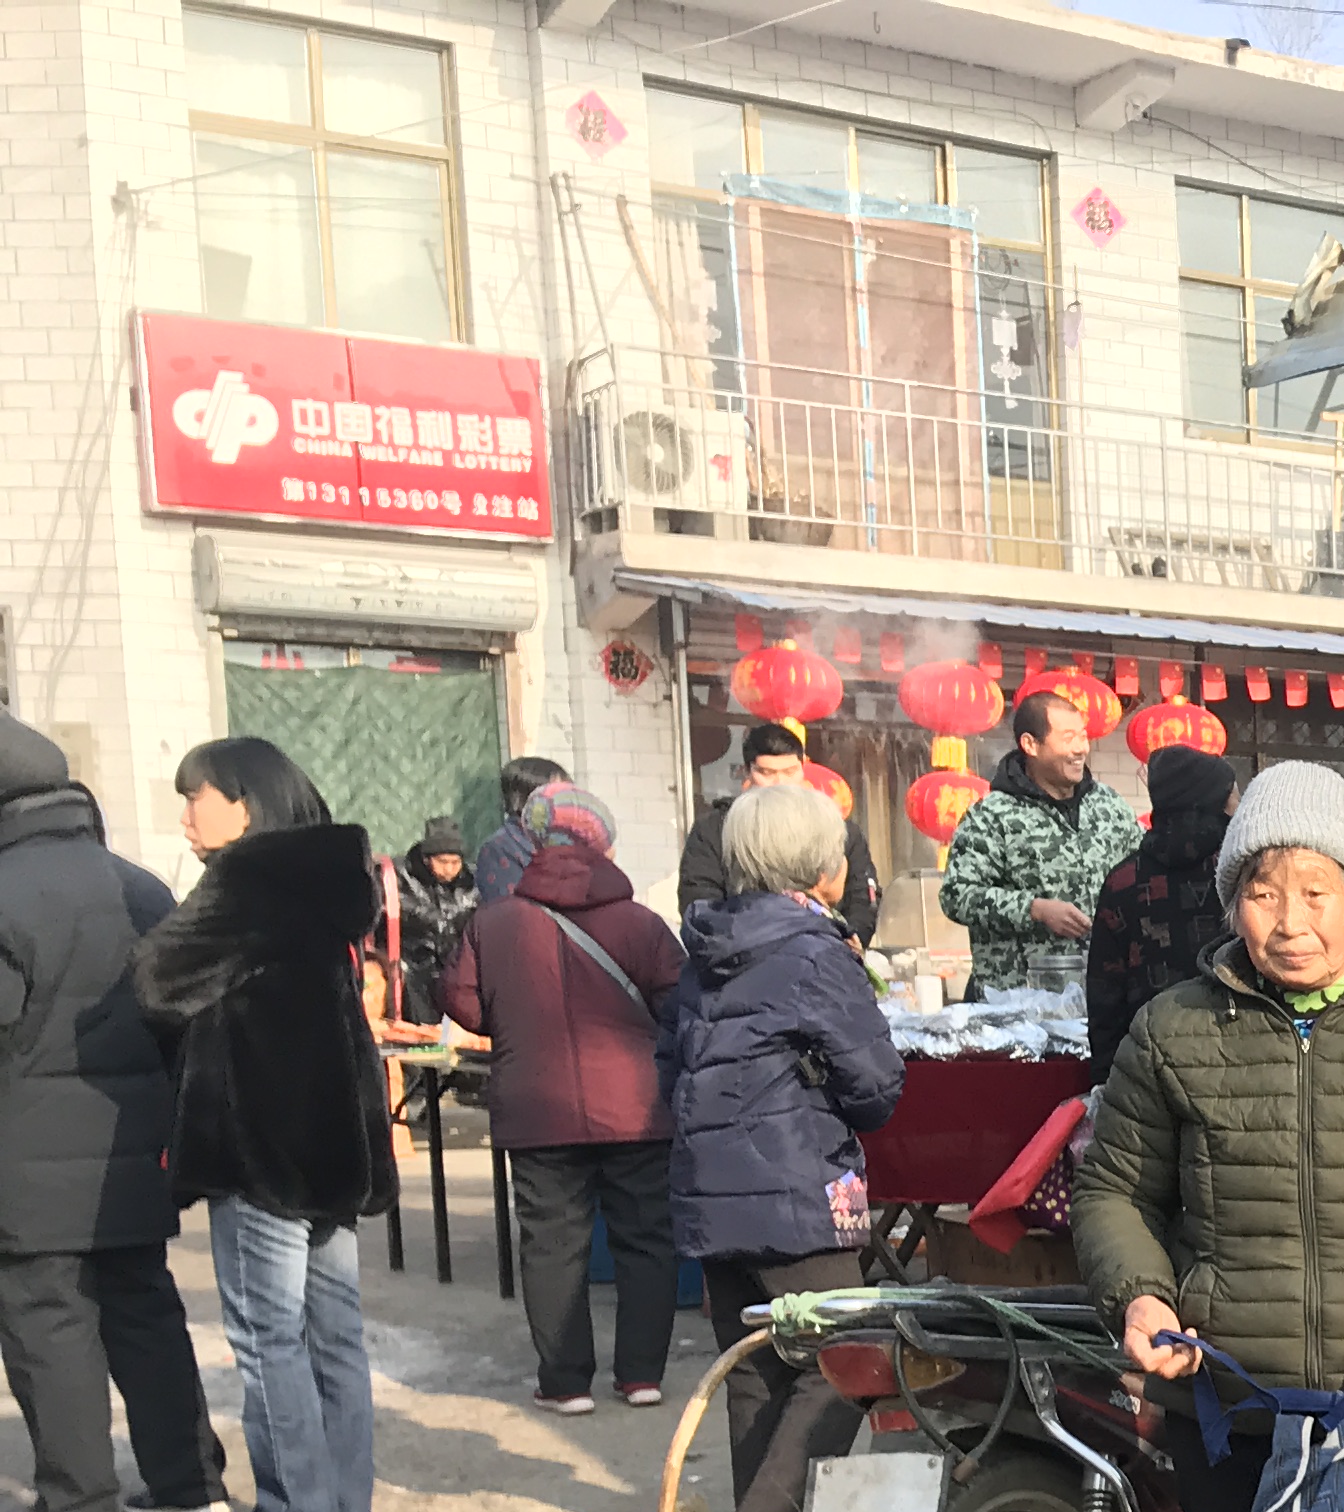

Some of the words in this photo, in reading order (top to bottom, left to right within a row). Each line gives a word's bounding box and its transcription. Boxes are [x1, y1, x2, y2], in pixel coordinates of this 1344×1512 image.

[291, 399, 534, 457] 中国福利彩票
[292, 437, 353, 459] CHINA
[360, 443, 444, 468] WELFARE
[453, 453, 534, 474] LOTTERY
